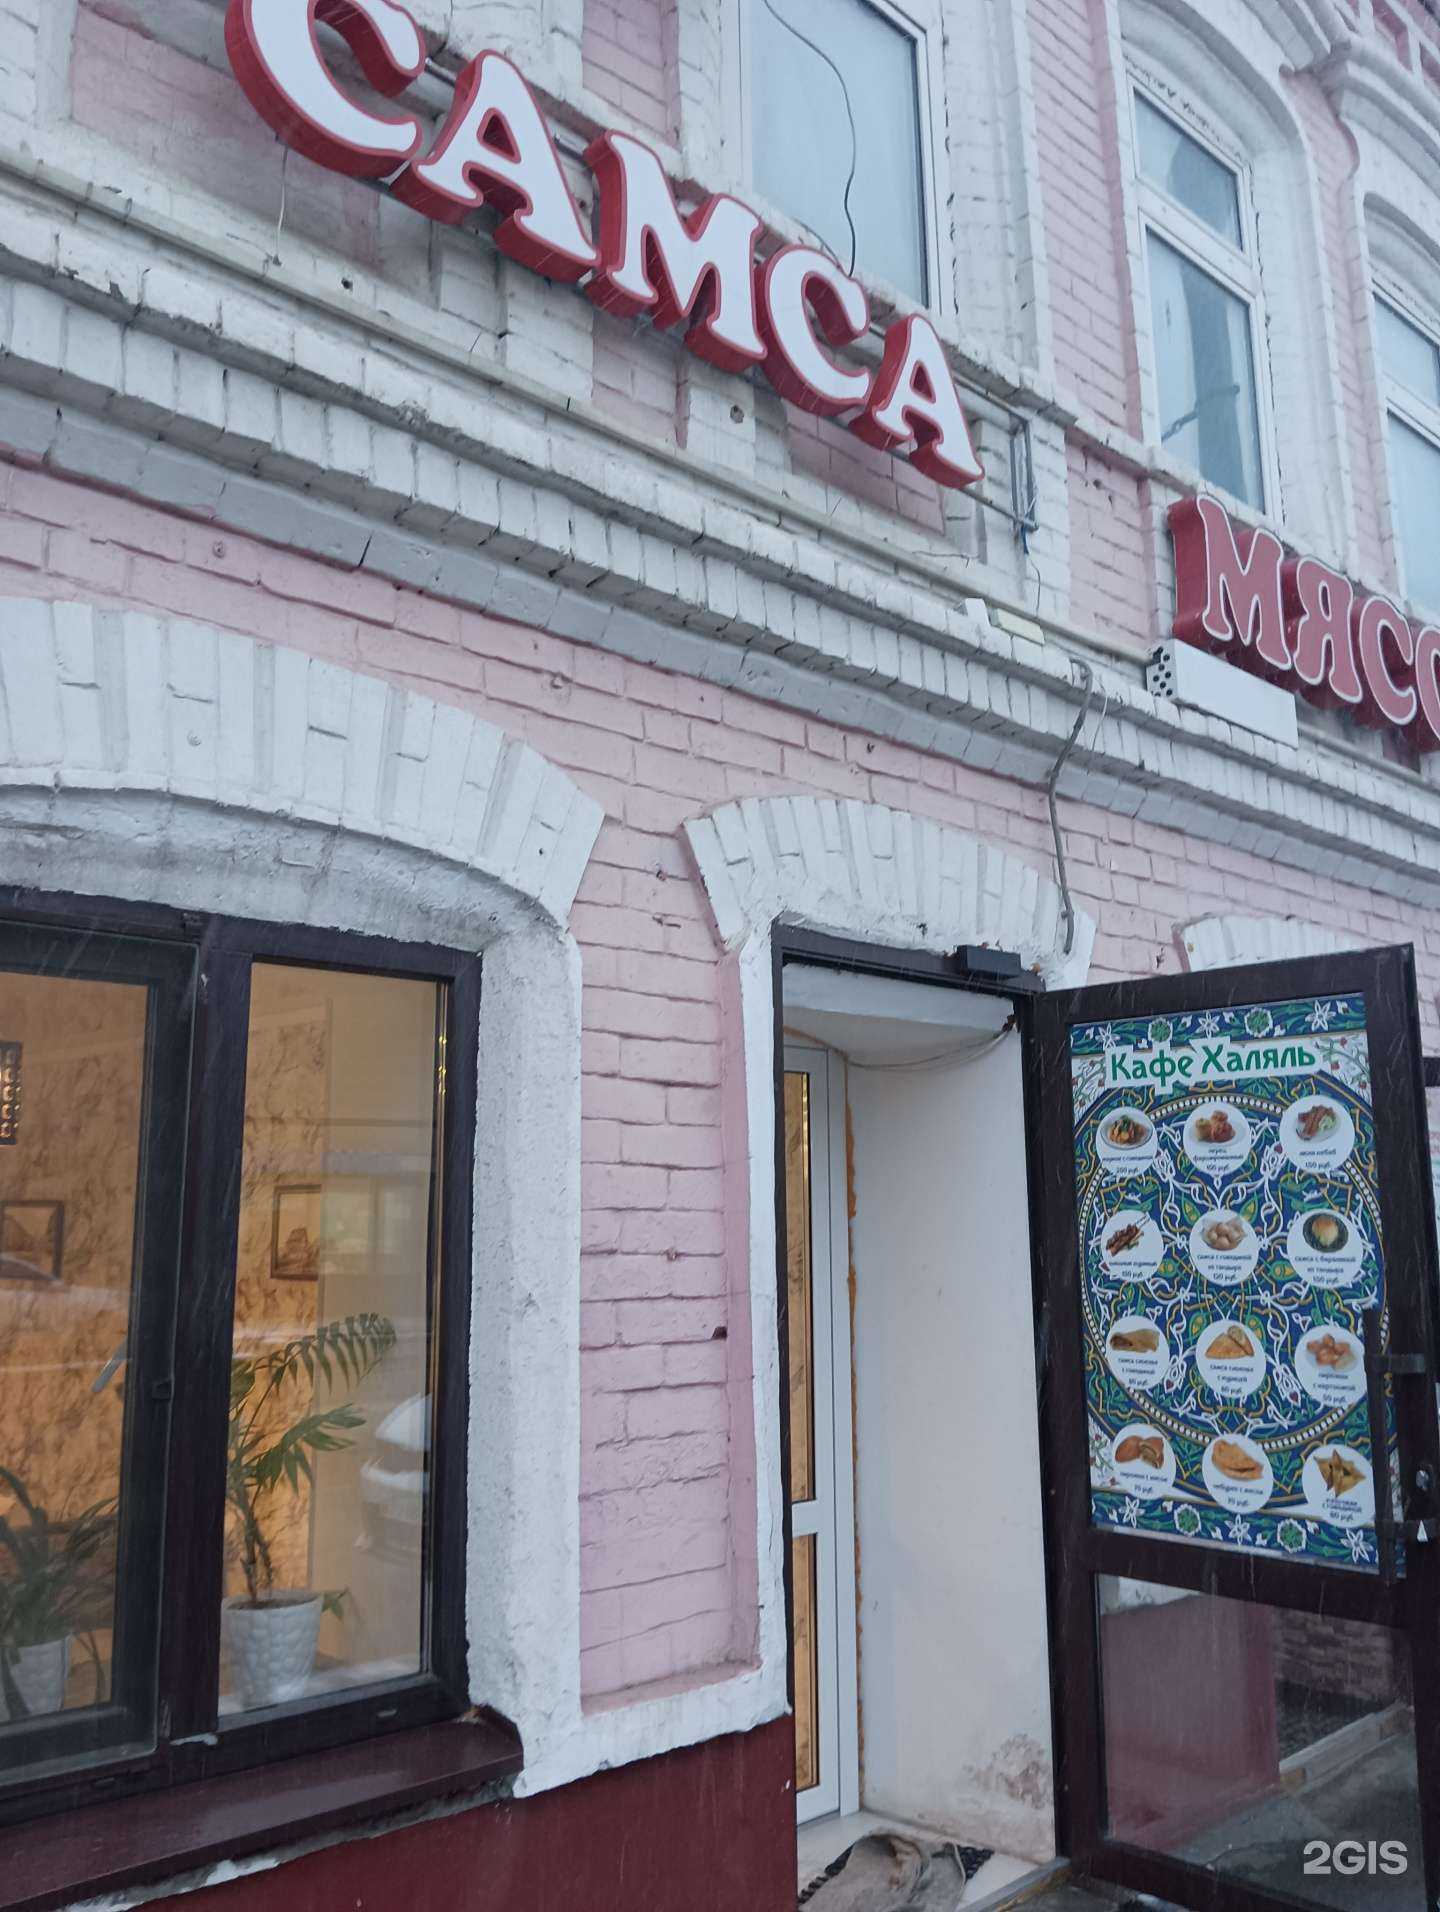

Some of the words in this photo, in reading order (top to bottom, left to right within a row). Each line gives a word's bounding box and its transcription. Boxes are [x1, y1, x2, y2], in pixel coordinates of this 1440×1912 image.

[232, 0, 984, 484] САМСА
[1111, 1050, 1194, 1087] Кафе
[1201, 1044, 1316, 1074] Халяль
